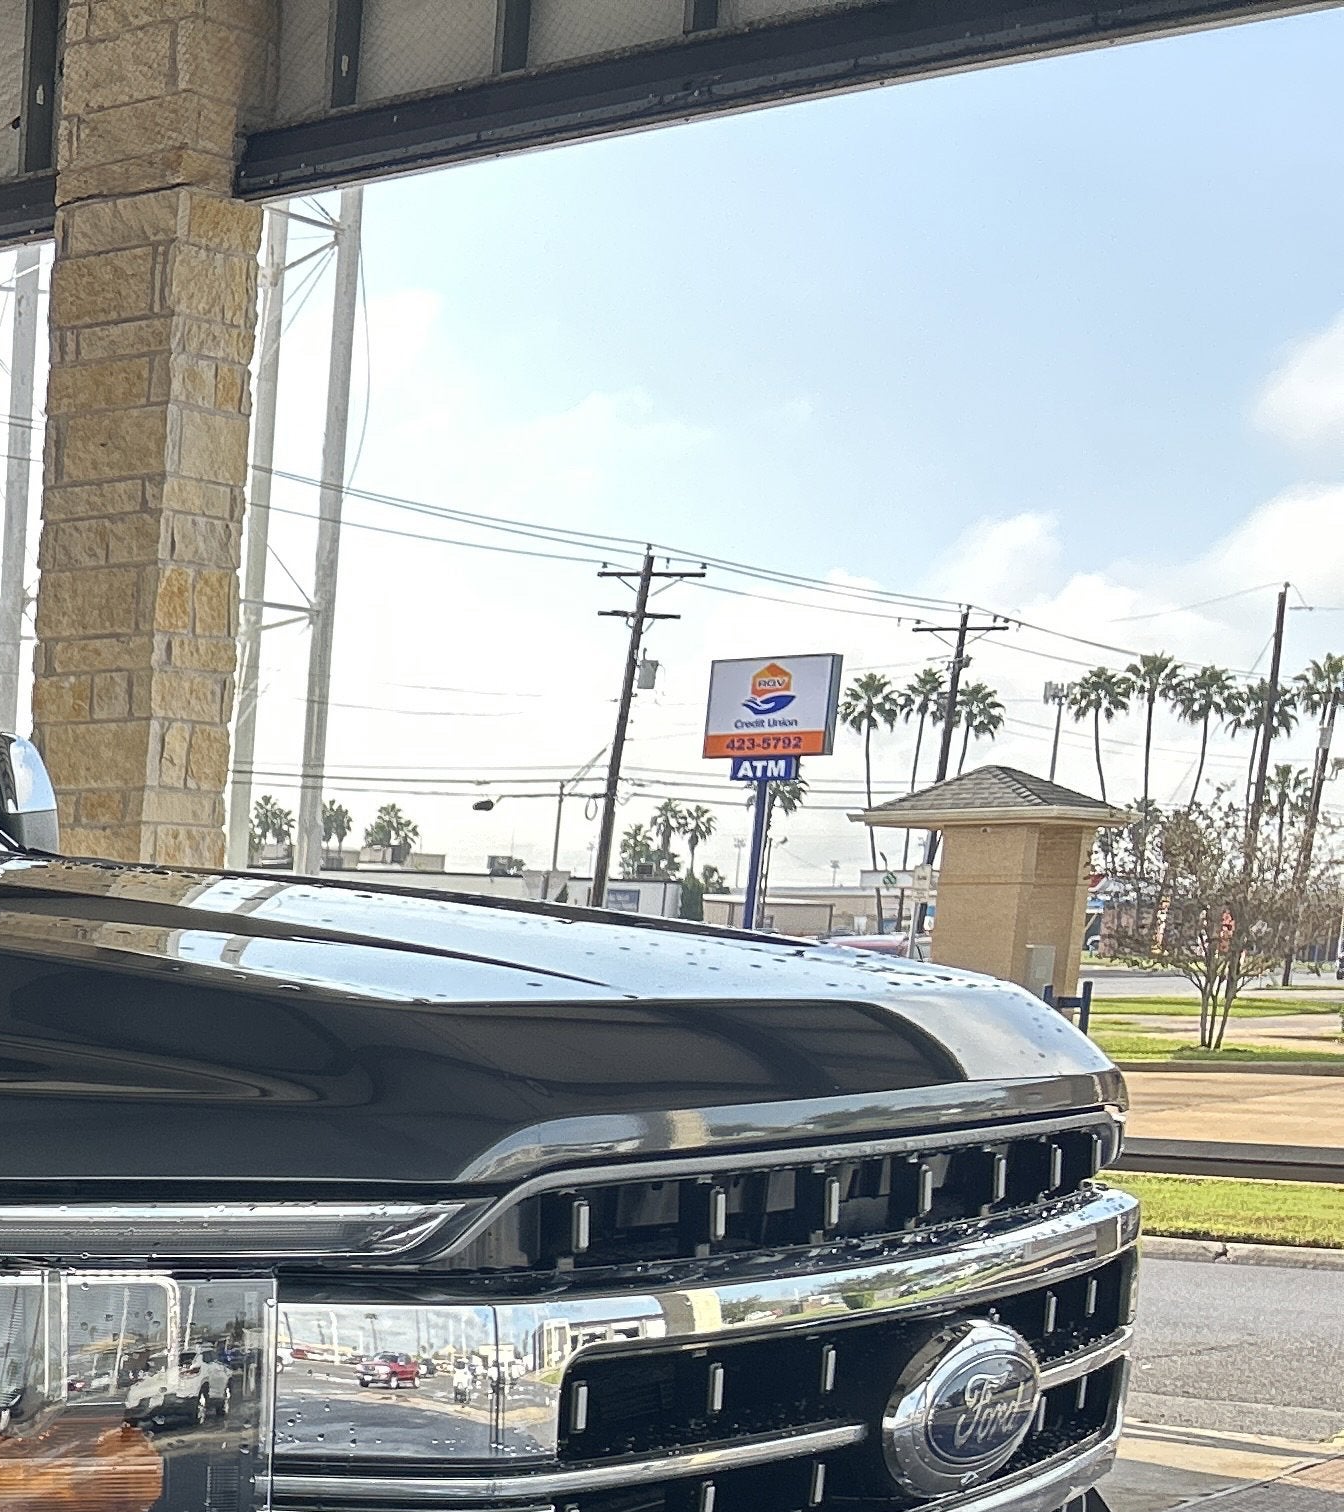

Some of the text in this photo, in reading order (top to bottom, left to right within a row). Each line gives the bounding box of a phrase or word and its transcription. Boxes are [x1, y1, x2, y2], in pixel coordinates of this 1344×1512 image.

[734, 718, 799, 730] Credit Union
[725, 736, 803, 751] 423-5792
[737, 760, 786, 778] ATM
[953, 1371, 1031, 1449] Ford
